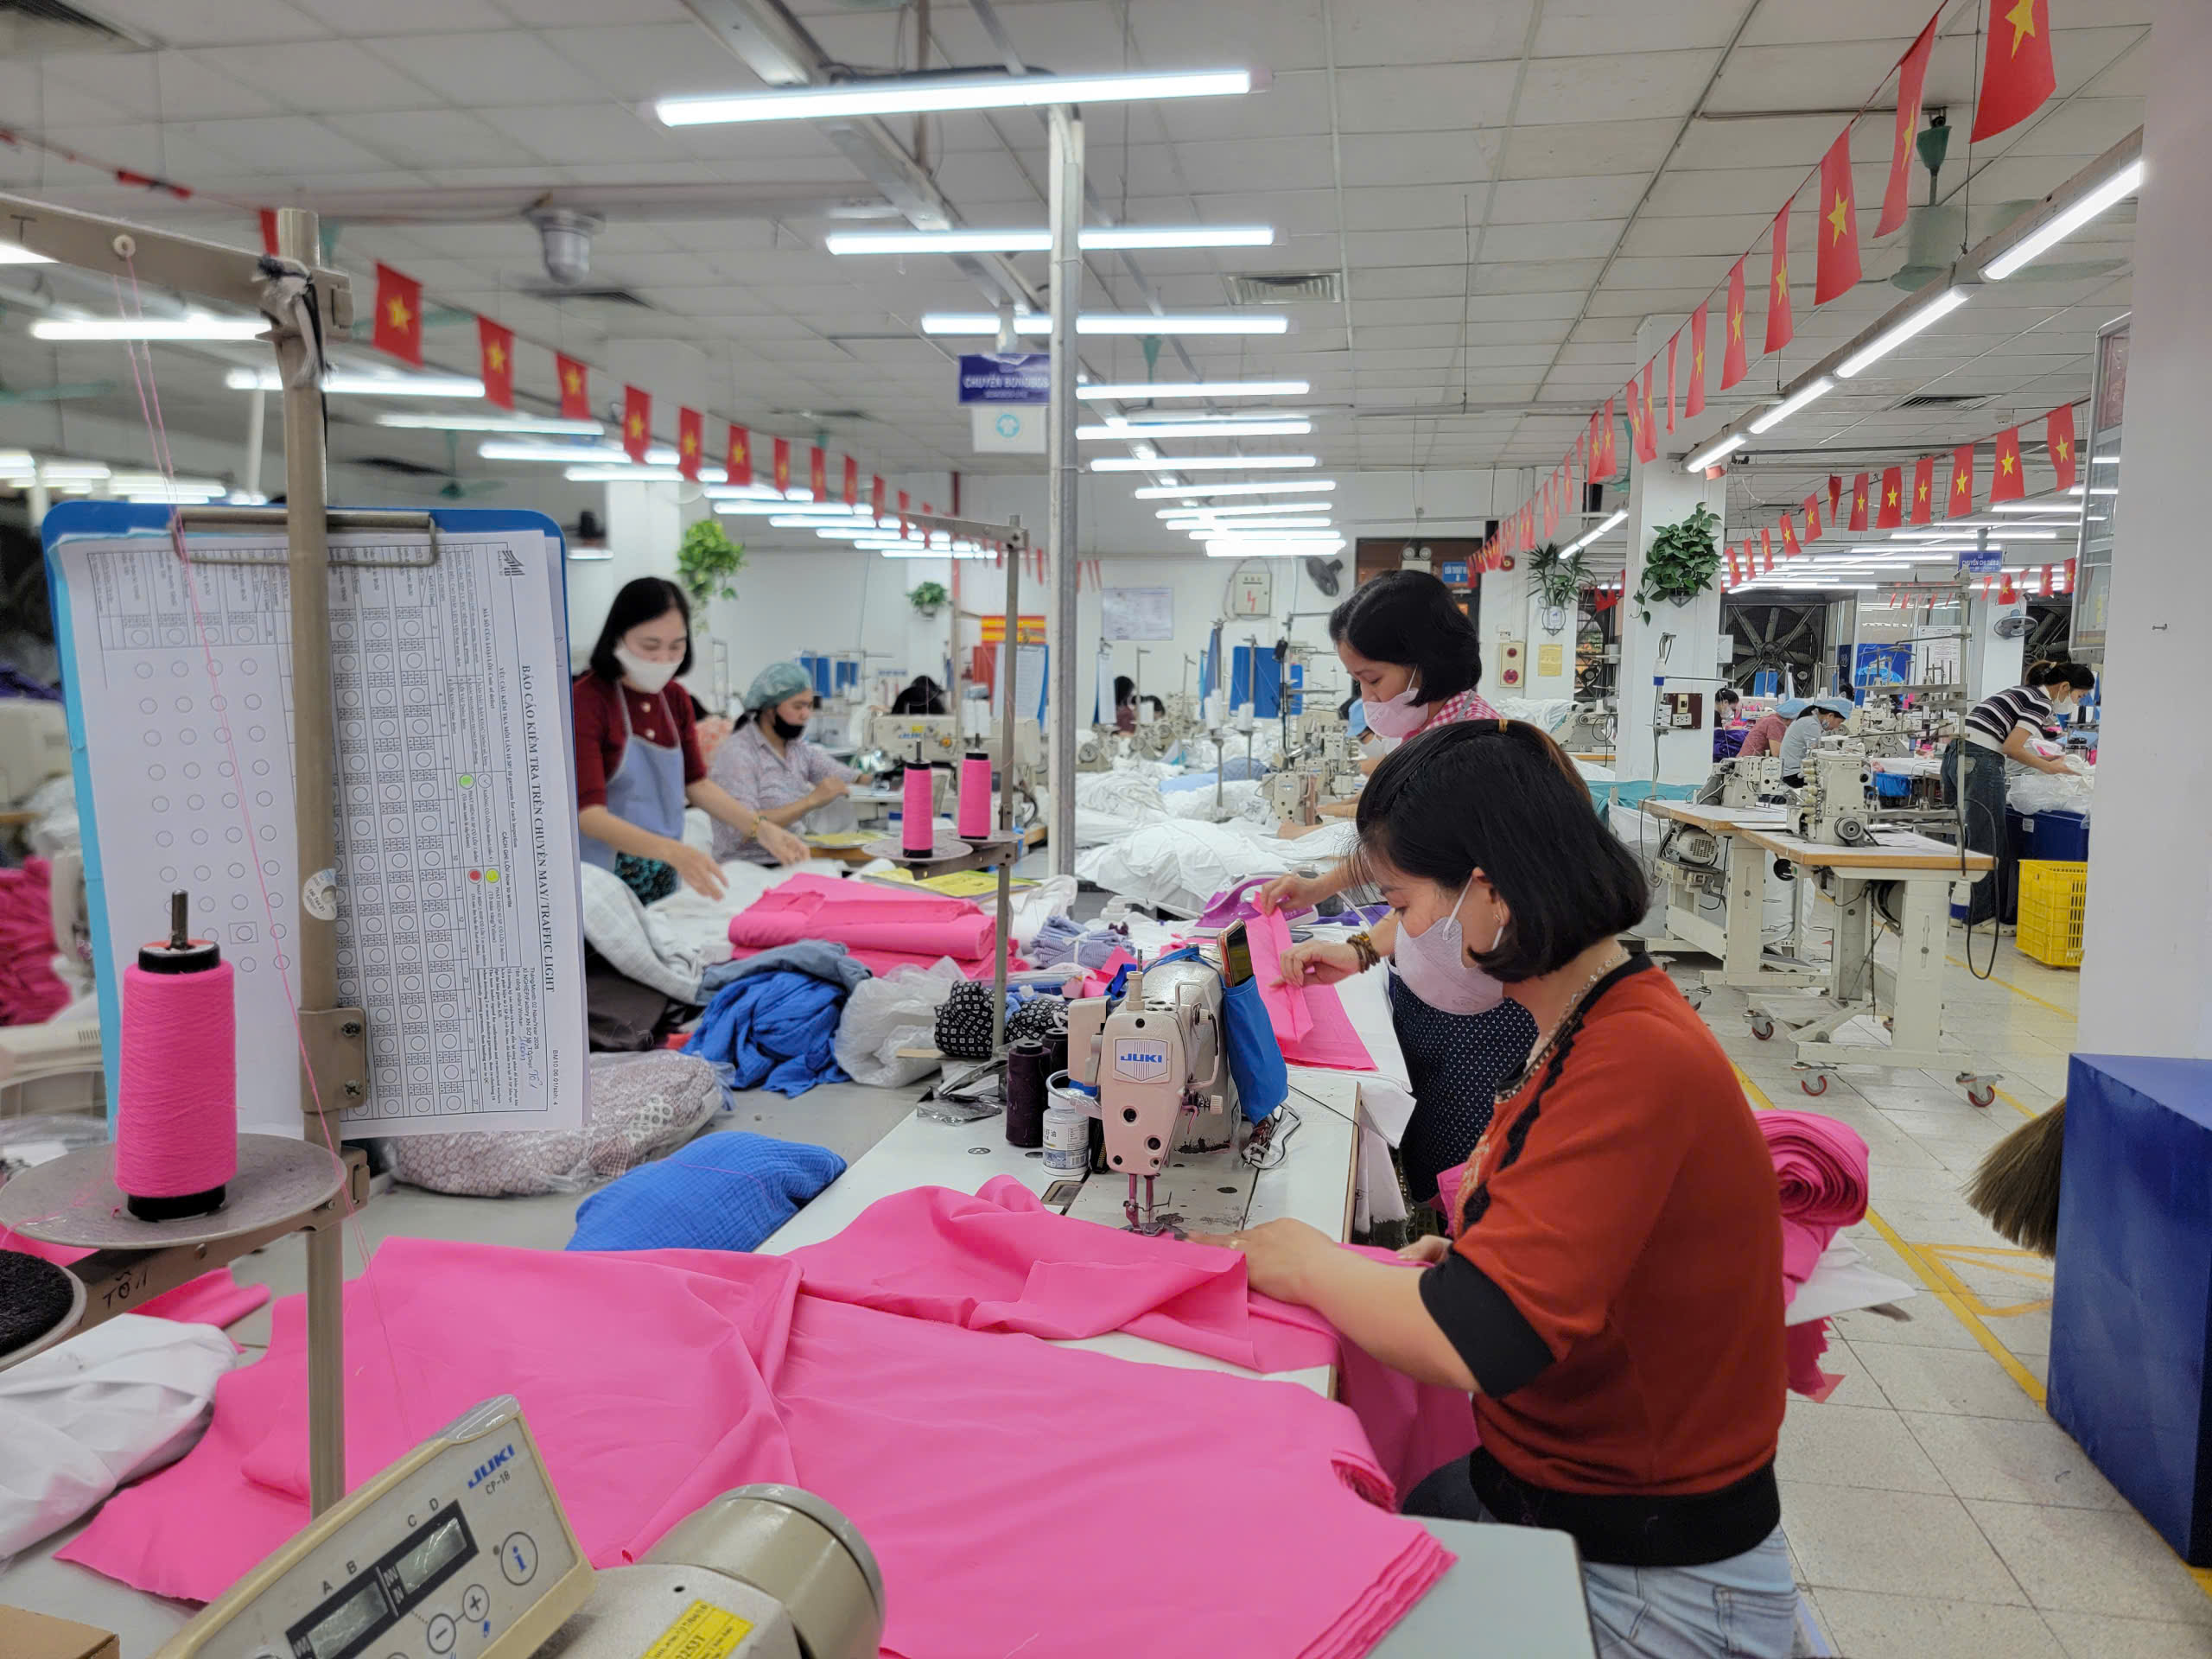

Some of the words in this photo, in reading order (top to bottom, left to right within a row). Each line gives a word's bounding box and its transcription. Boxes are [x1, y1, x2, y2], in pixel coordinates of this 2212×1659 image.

[524, 693, 537, 718] CÁO
[530, 756, 540, 780] TRA
[532, 784, 544, 814] TRÊN
[540, 903, 553, 953] TRAFFIC
[544, 957, 555, 993] LIGHT
[1120, 1053, 1162, 1063] JUKI
[467, 1444, 516, 1489] JUKI
[485, 1471, 511, 1496] CP-18
[322, 1580, 334, 1596] A
[346, 1560, 358, 1575] B
[408, 1514, 417, 1528] C
[429, 1497, 440, 1511] D
